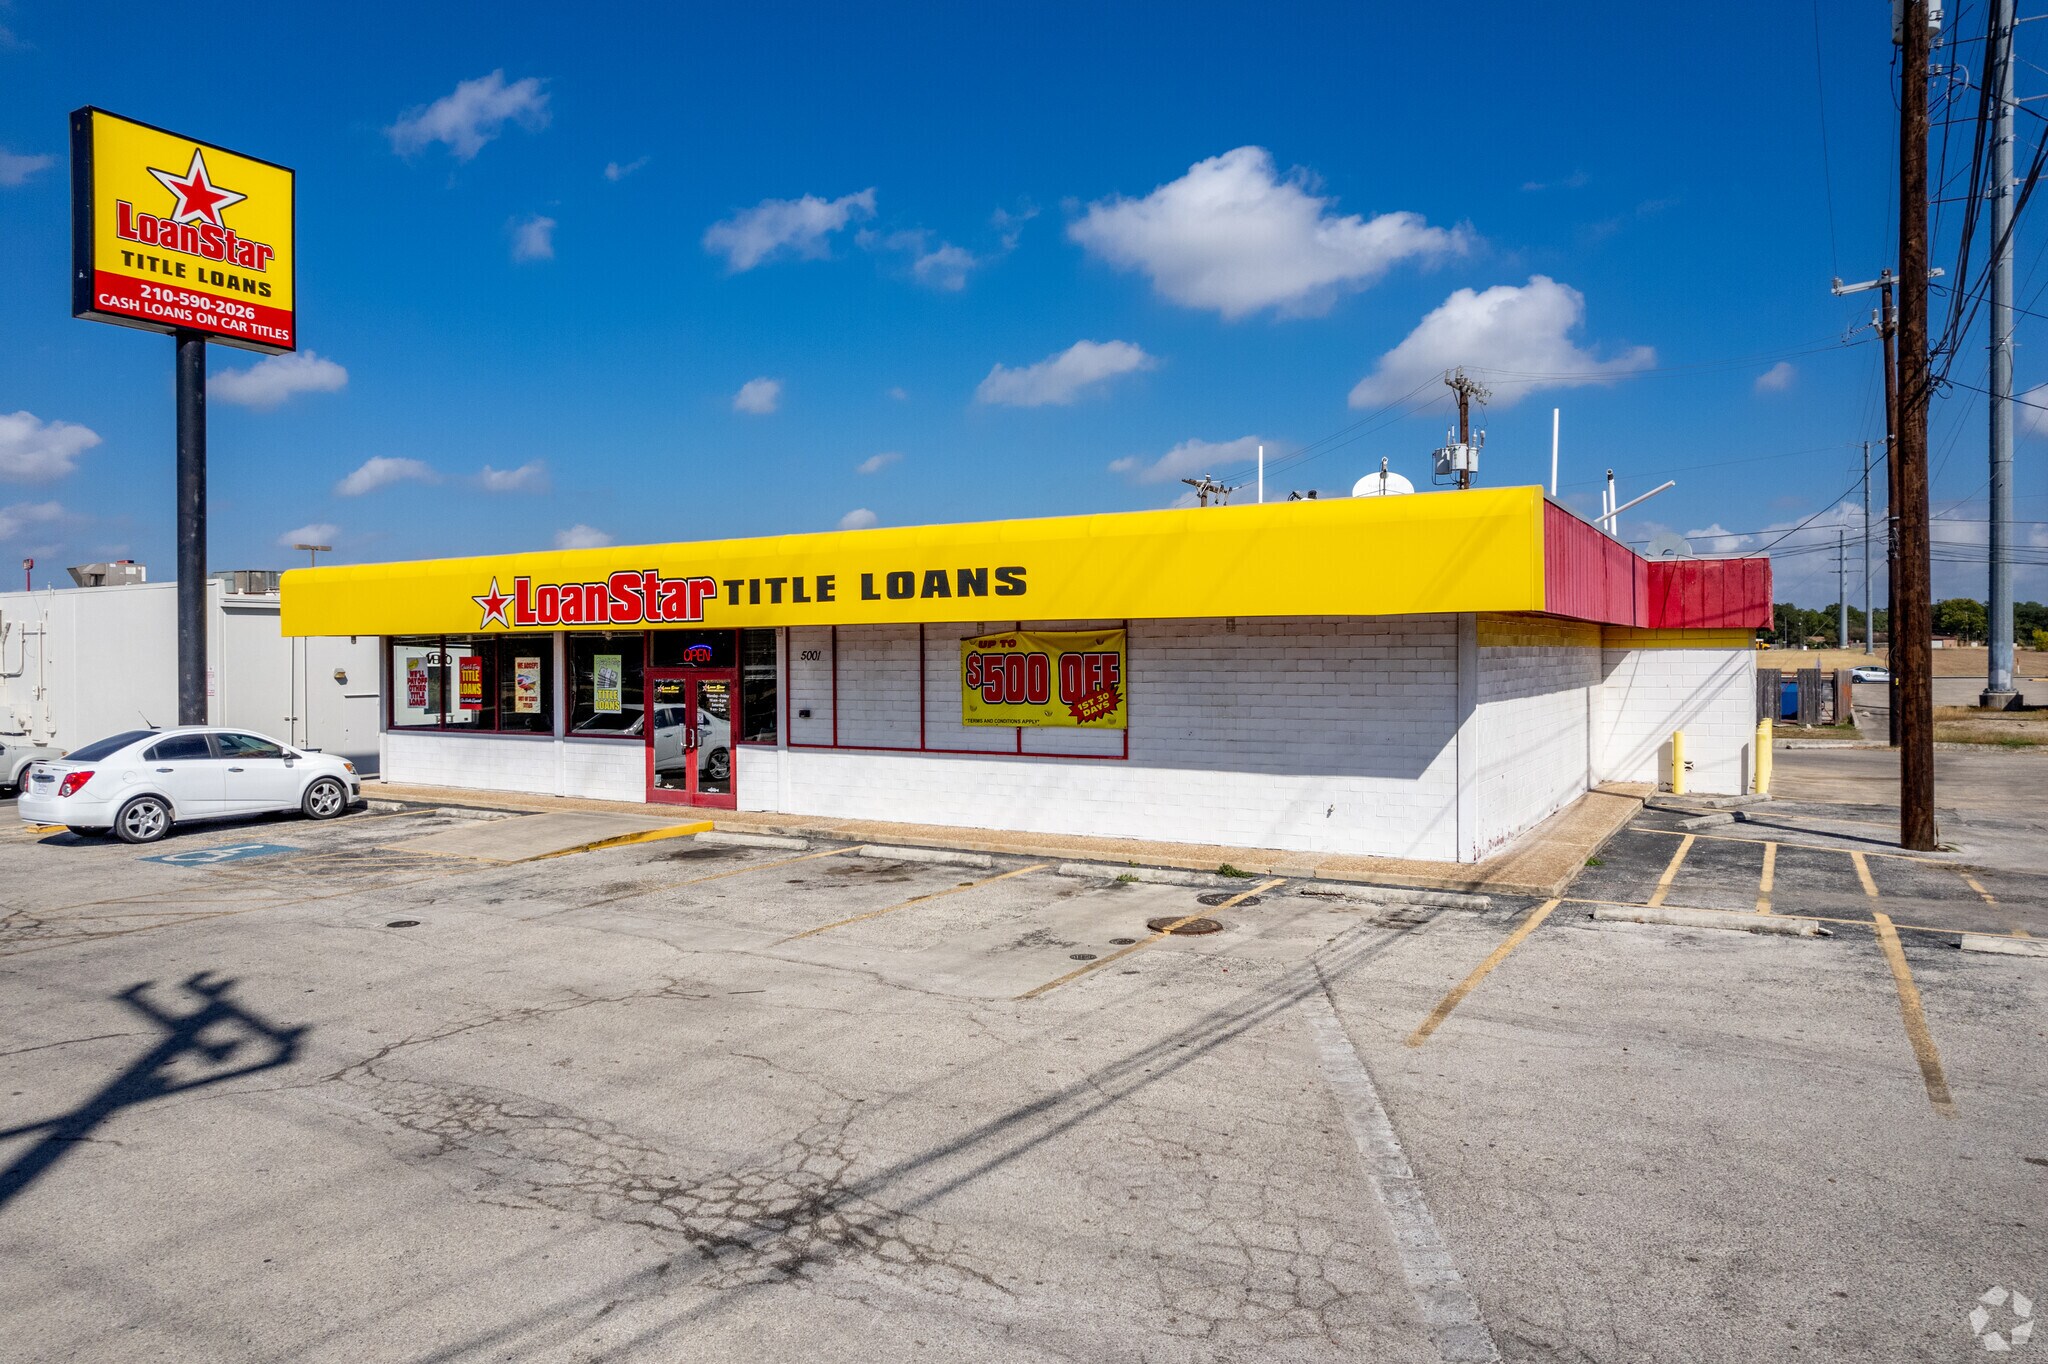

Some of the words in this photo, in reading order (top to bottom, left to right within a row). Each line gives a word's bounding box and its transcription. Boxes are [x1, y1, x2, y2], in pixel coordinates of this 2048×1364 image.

[116, 199, 275, 272] LoanStar
[121, 250, 186, 279] TITLE
[198, 267, 272, 298] LOANS
[140, 284, 255, 320] 210-590-2026
[98, 294, 140, 311] CASH
[144, 301, 193, 321] LOANS
[196, 312, 218, 326] ON
[221, 318, 248, 332] CAR
[250, 323, 289, 340] TITLES
[514, 569, 717, 626] LoanStar
[723, 574, 836, 606] TITLE
[861, 566, 1027, 601] LOANS
[978, 640, 997, 649] UP
[1000, 638, 1017, 648] TO
[683, 648, 711, 662] OPEN
[800, 650, 821, 661] 5001
[461, 670, 480, 682] TITLE
[966, 651, 1051, 705] $500
[1058, 652, 1121, 705] OFF
[408, 684, 426, 692] OTHER
[460, 683, 482, 695] LOANS
[597, 689, 618, 700] TITLE
[410, 691, 425, 699] TITLE
[1077, 699, 1094, 711] 1ST
[1097, 692, 1110, 703] 30
[409, 698, 426, 706] LOANS
[595, 700, 620, 711] LOANS
[1082, 700, 1110, 717] DAYS
